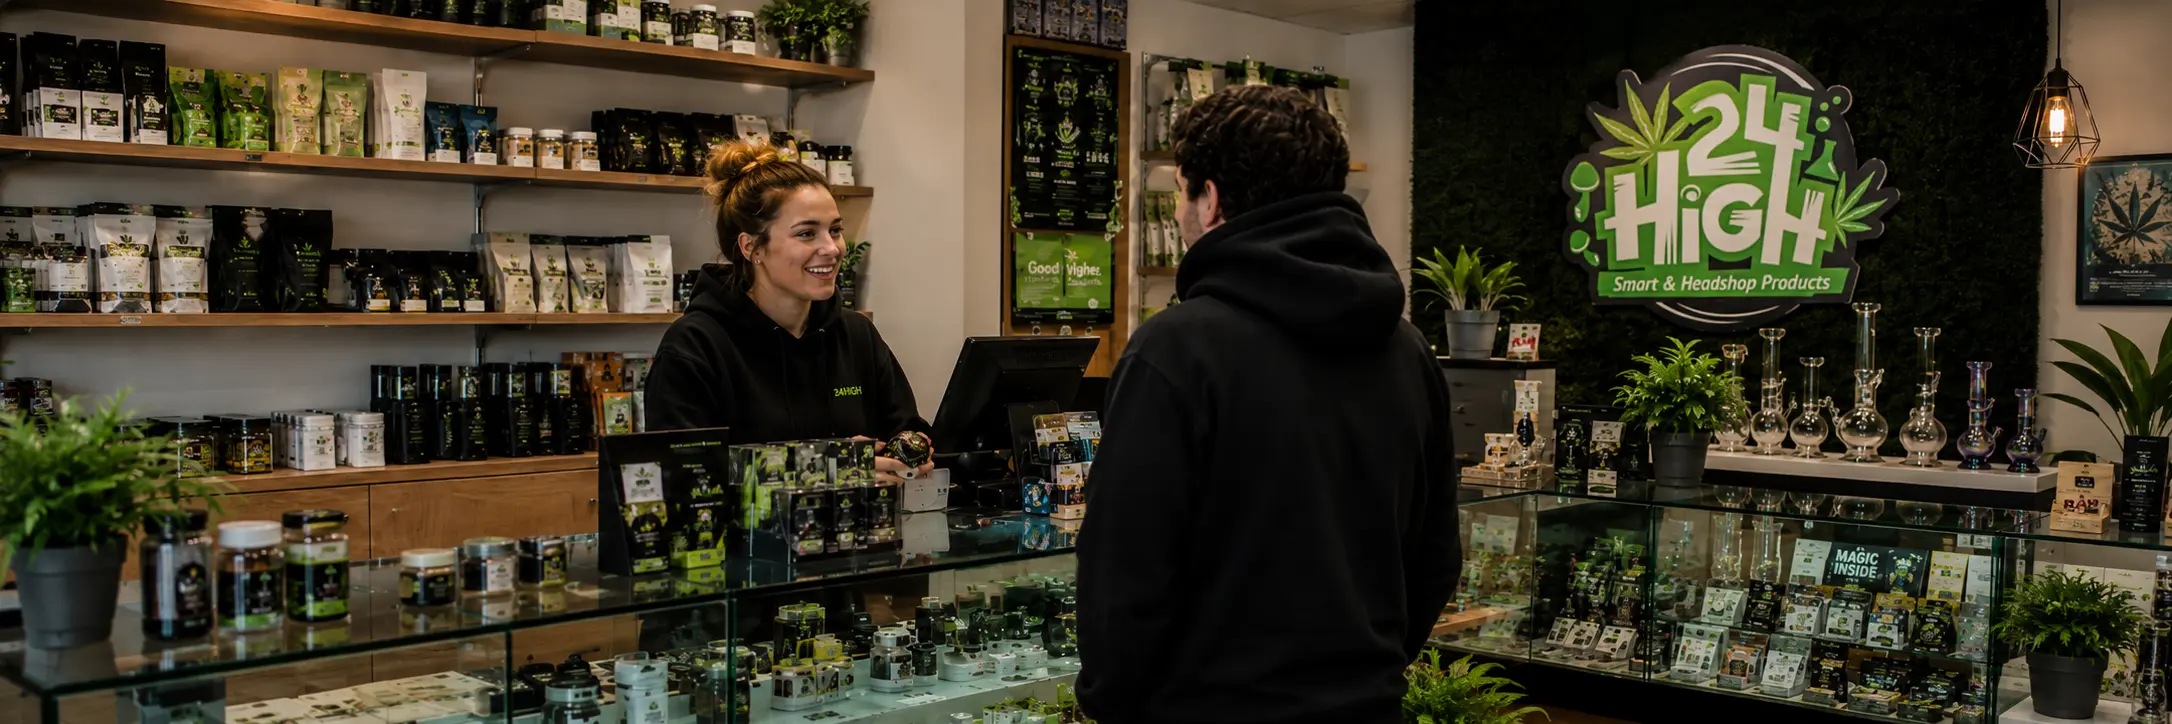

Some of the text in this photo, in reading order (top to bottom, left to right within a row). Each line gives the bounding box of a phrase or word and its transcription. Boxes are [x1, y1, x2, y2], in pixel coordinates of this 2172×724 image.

[1687, 83, 1805, 177] 24
[1028, 260, 1060, 275] Good
[1613, 274, 1831, 294] Smart & Headshop Products
[1835, 549, 1879, 565] MAGIC
[1833, 562, 1878, 579] INSIDE
